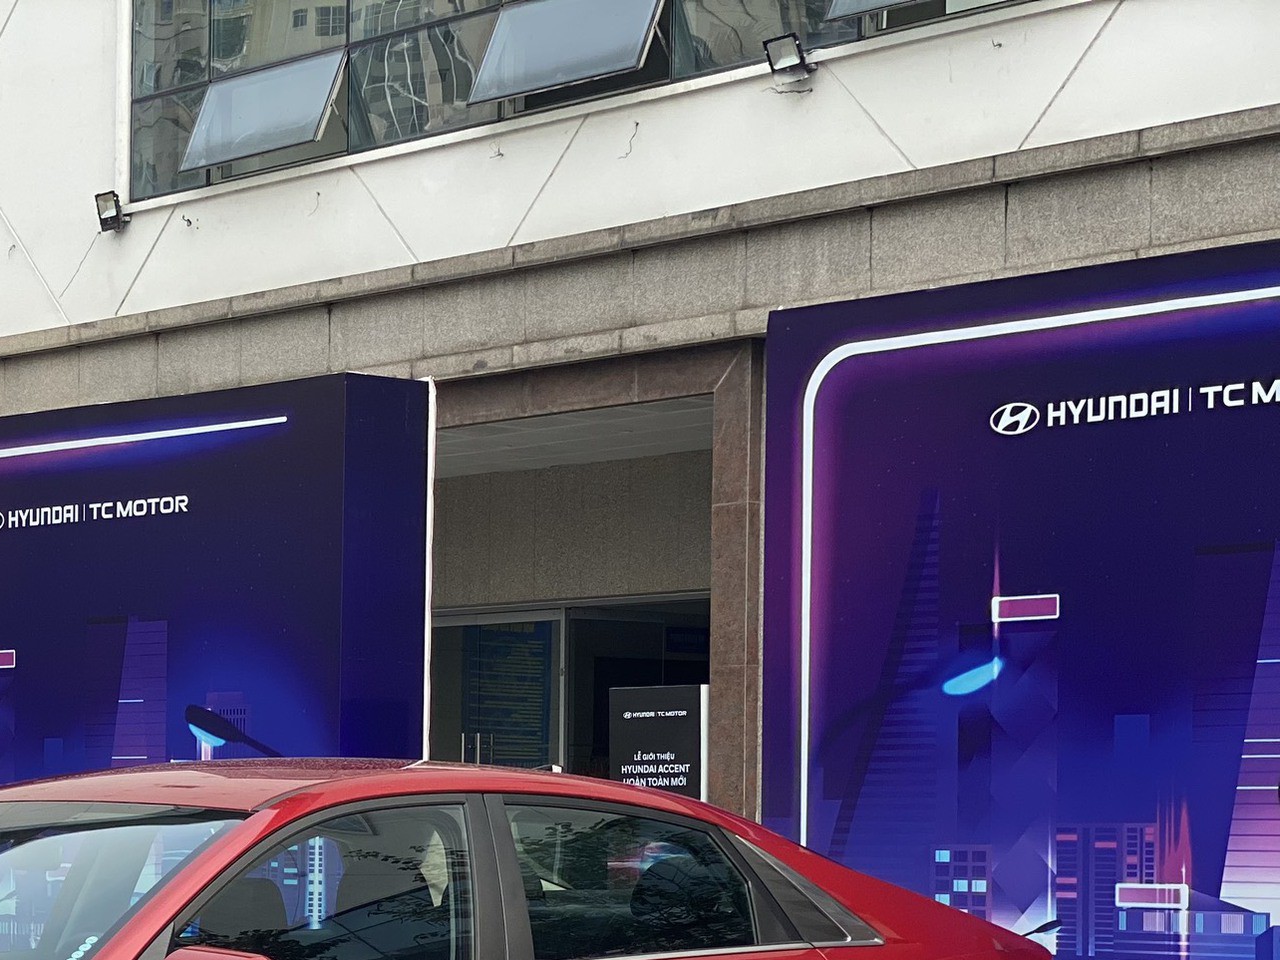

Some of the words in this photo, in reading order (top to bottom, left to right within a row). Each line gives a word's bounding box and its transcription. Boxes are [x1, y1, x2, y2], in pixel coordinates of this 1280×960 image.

[1047, 388, 1180, 427] HYUNDAI
[1199, 383, 1245, 410] TC
[7, 504, 79, 529] HYUNDAI
[89, 502, 114, 520] TC
[116, 495, 189, 518] MOTOR
[621, 764, 657, 774] HYUNDAI
[658, 764, 690, 773] ACCENT
[647, 775, 669, 786] TOÀN
